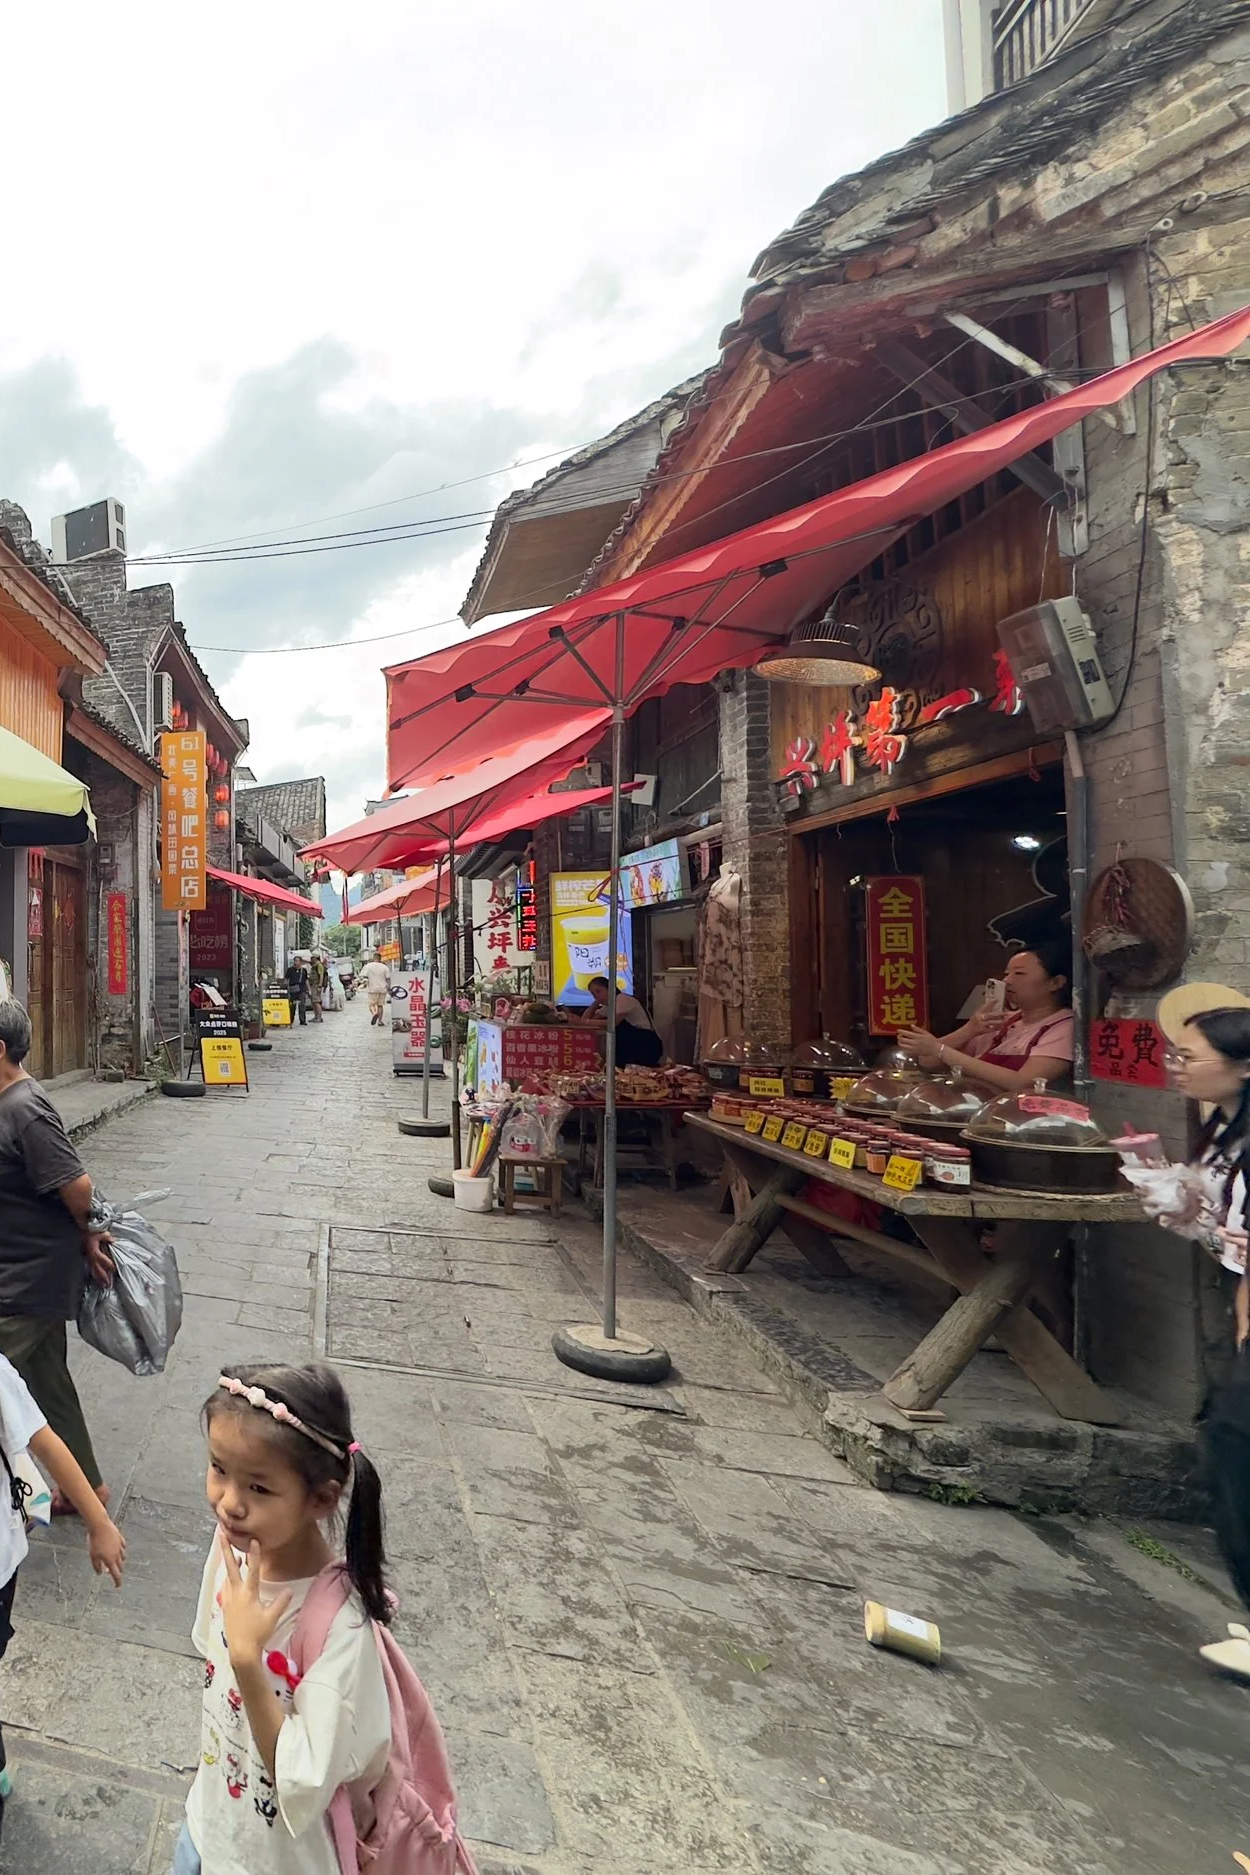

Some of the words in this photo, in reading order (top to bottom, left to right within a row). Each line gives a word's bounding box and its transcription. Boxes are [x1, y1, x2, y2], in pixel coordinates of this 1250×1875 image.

[180, 736, 200, 898] 61号餐吧总店
[878, 887, 917, 1026] 全国快递
[409, 977, 426, 1047] 水晶玉器
[564, 1029, 573, 1040] 5
[564, 1044, 573, 1054] 5
[564, 1055, 573, 1066] 6
[1097, 1022, 1158, 1067] 免費
